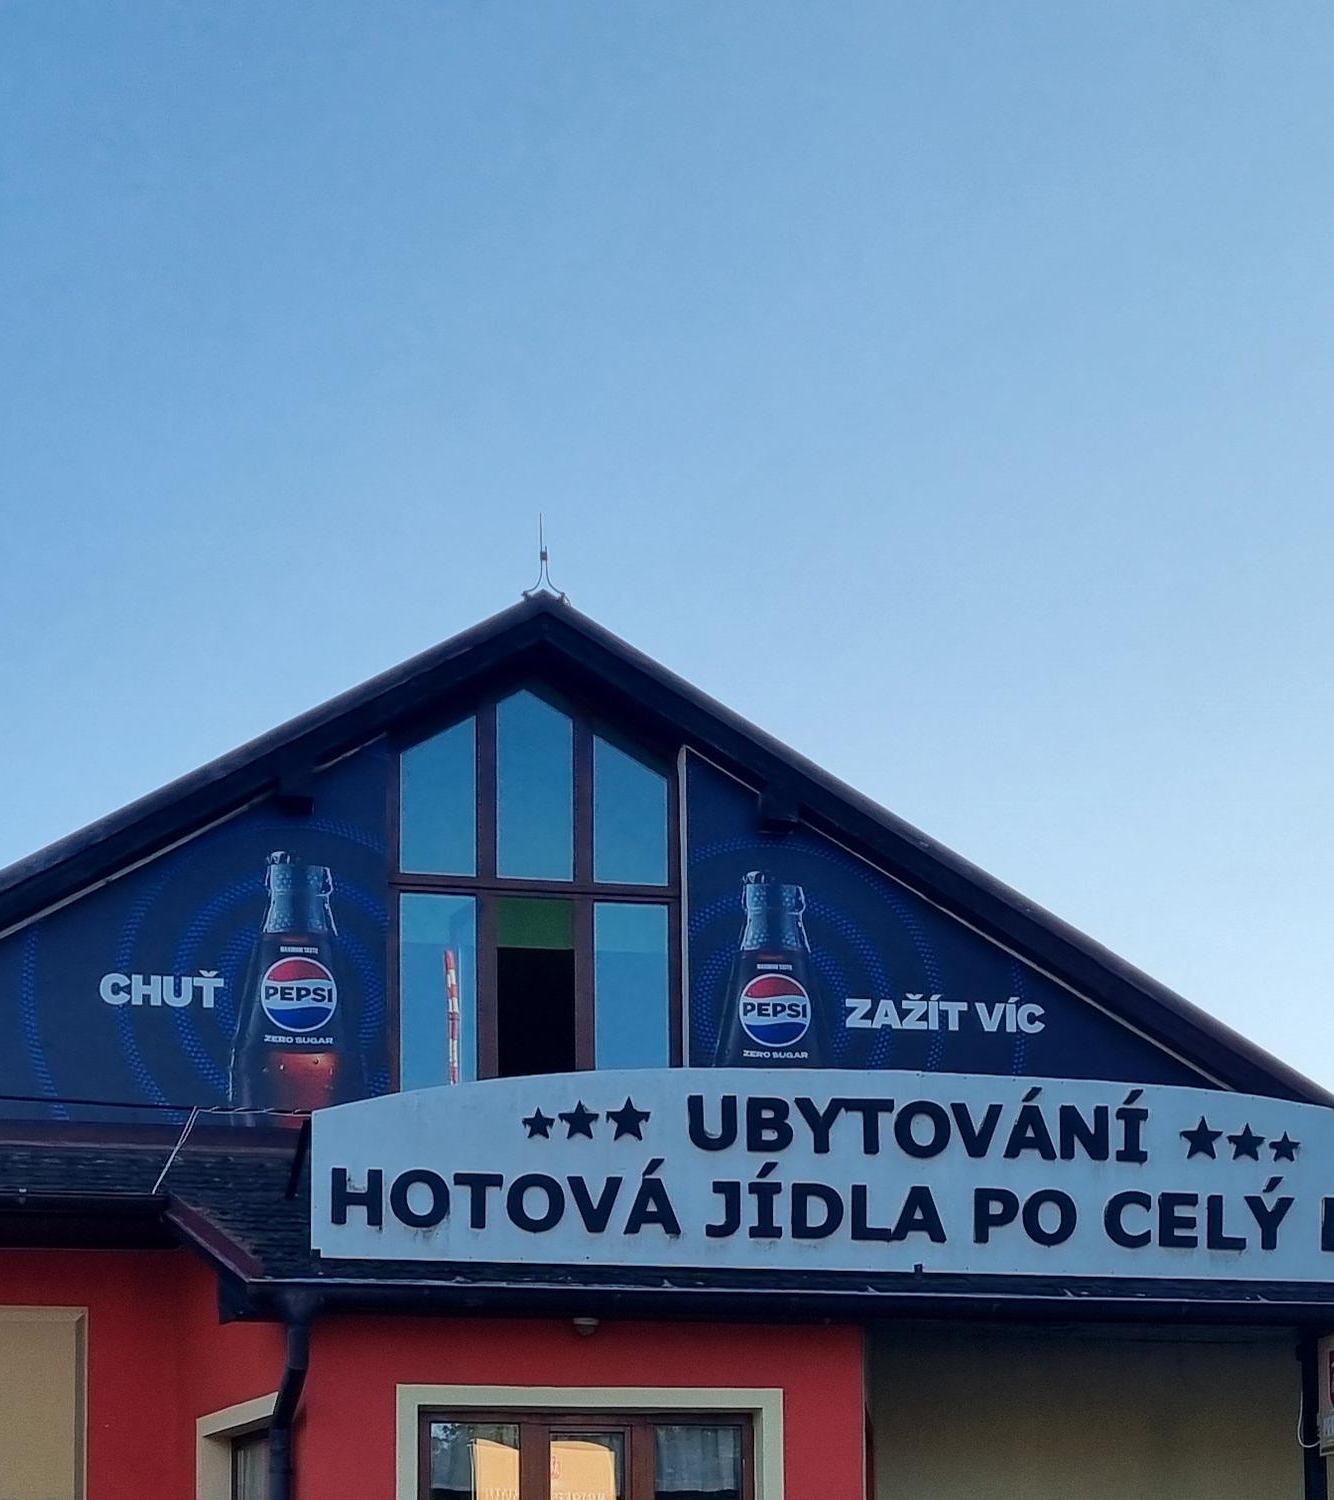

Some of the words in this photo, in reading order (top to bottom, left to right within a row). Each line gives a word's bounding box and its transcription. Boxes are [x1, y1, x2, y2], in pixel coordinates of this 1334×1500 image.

[99, 970, 225, 1008] CHUŤ
[264, 985, 333, 1003] PEPSI
[742, 1002, 807, 1019] PEPSI
[845, 993, 968, 1031] ZAŽÍT
[974, 997, 1046, 1034] VÍC
[264, 1035, 293, 1044] ZERO
[295, 1037, 334, 1045] SUGAR
[743, 1050, 771, 1058] ZERO
[687, 1086, 1149, 1164] UBYTOVÁNÍ
[330, 1158, 682, 1236] HOTOVÁ
[704, 1161, 947, 1243] JÍDLA
[973, 1187, 1077, 1247] PO
[1104, 1175, 1295, 1251] CELÝ
